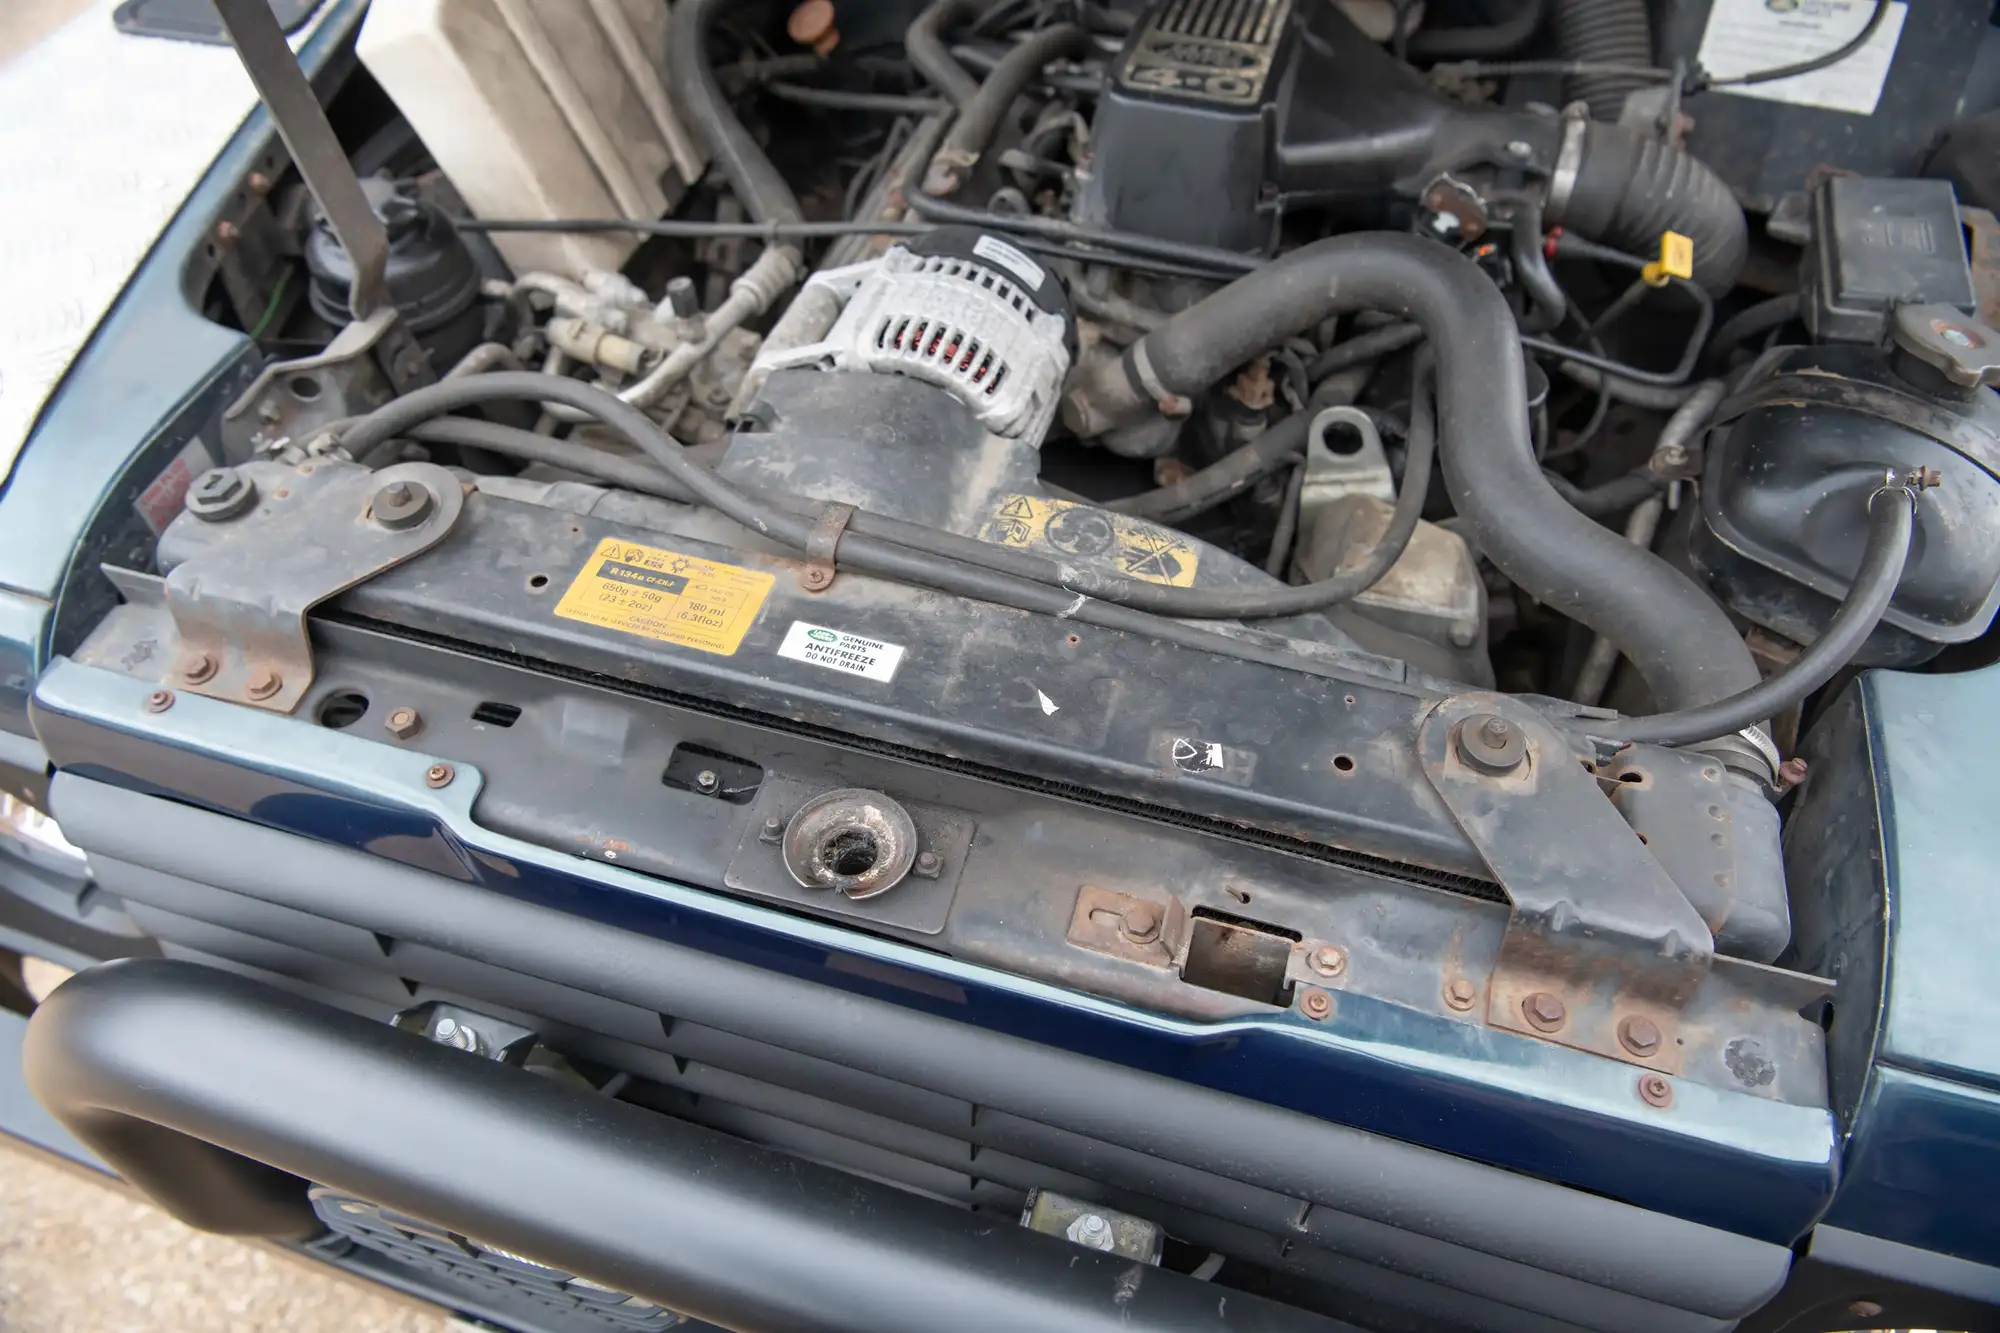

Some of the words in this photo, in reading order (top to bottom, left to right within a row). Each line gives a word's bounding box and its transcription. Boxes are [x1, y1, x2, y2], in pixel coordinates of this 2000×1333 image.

[602, 582, 629, 596] 650g
[641, 591, 663, 604] 50g
[627, 600, 653, 612] 2oz)
[689, 601, 707, 612] 180
[709, 608, 727, 617] ml
[629, 615, 667, 629] CAUTION
[839, 641, 867, 653] PARTS
[842, 635, 884, 650] GENUINE
[804, 642, 877, 666] ANTIFREEZE
[805, 651, 818, 660] DO
[819, 655, 838, 665] NOT
[839, 660, 866, 672] DRAIN
